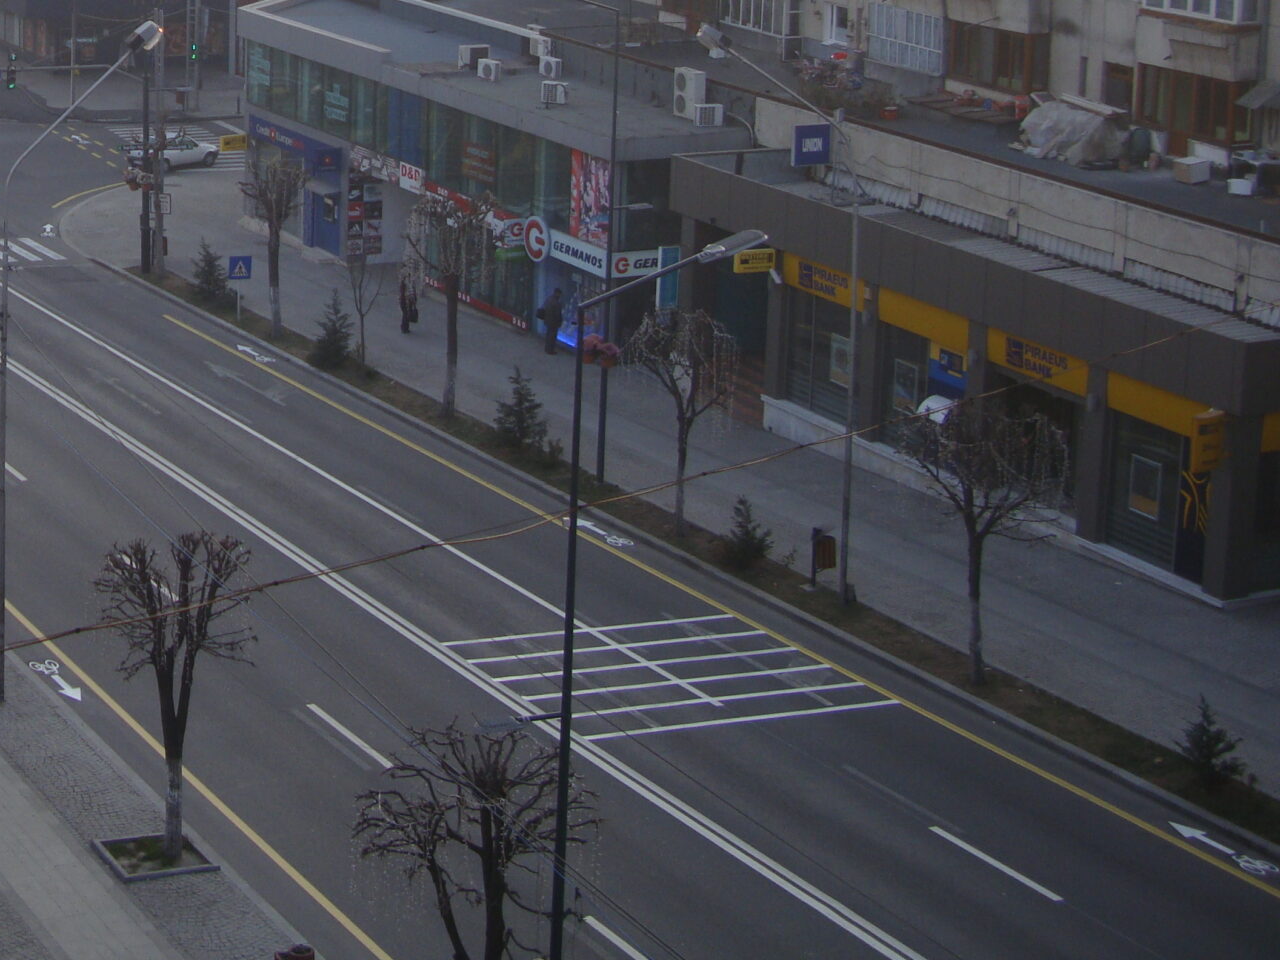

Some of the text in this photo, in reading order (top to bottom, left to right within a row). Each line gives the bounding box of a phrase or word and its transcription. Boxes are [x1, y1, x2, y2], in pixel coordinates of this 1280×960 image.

[401, 163, 421, 182] D&D
[553, 240, 603, 270] GERMANOS
[813, 265, 848, 289] PIRAEUS
[813, 280, 837, 297] BANK
[1024, 343, 1068, 370] PIRAEUS
[1024, 358, 1053, 379] BANK
